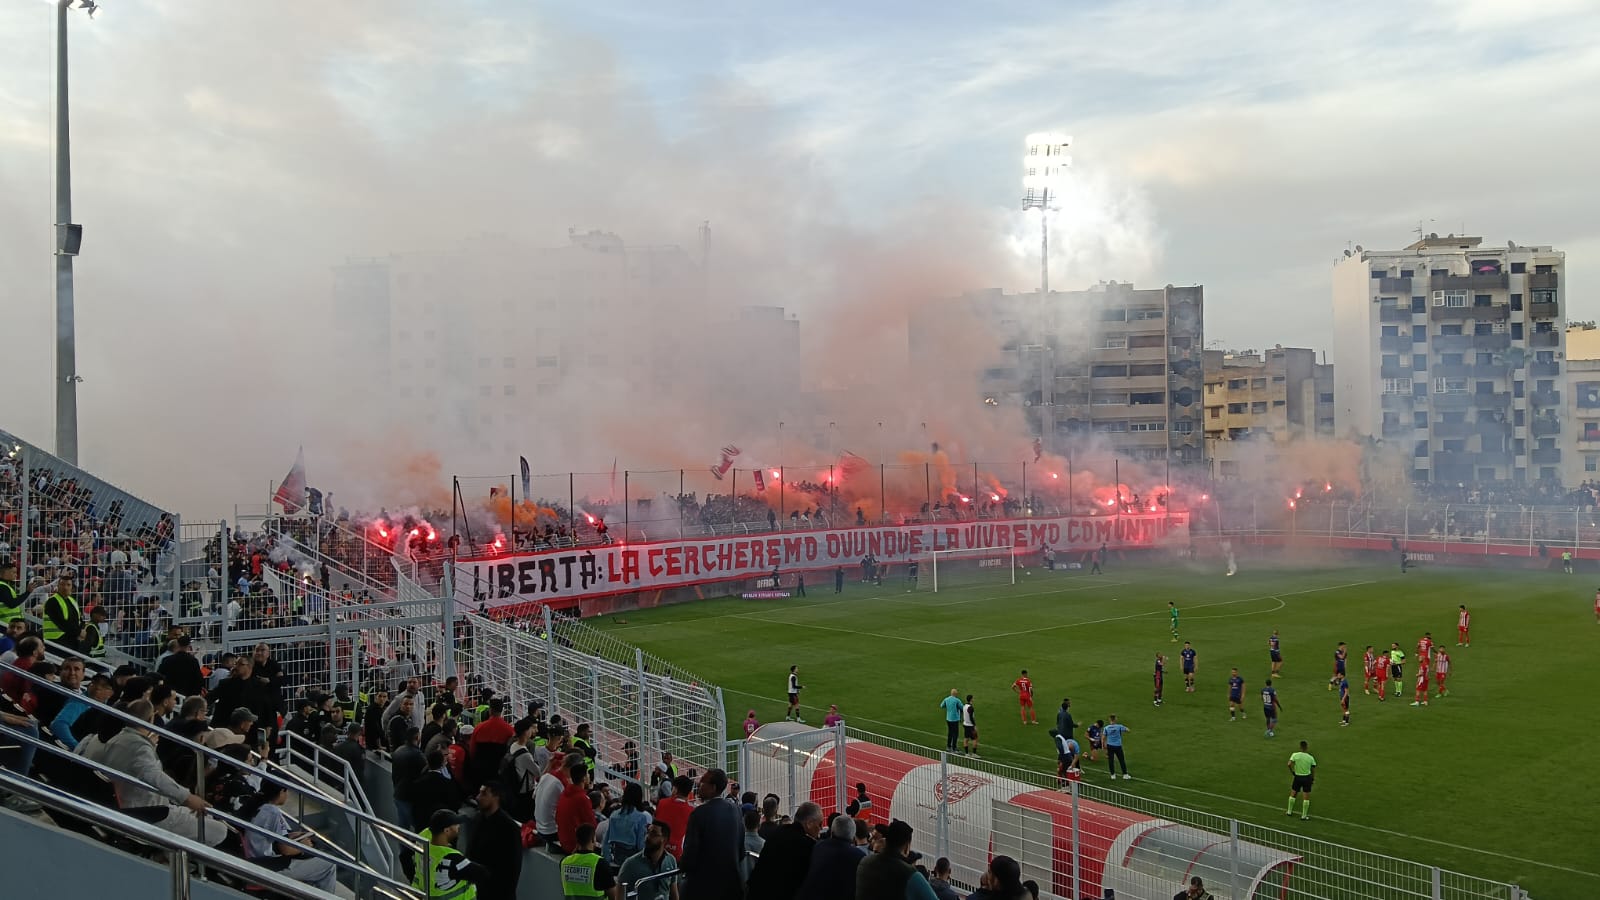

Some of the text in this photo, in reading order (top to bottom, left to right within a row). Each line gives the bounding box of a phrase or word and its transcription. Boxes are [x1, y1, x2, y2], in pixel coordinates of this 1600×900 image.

[472, 551, 603, 602] LIBERTÀ:
[608, 550, 640, 585] LA
[648, 536, 818, 577] CERCHEREMO
[933, 528, 960, 551] LA
[965, 523, 1060, 548] VIVREMO
